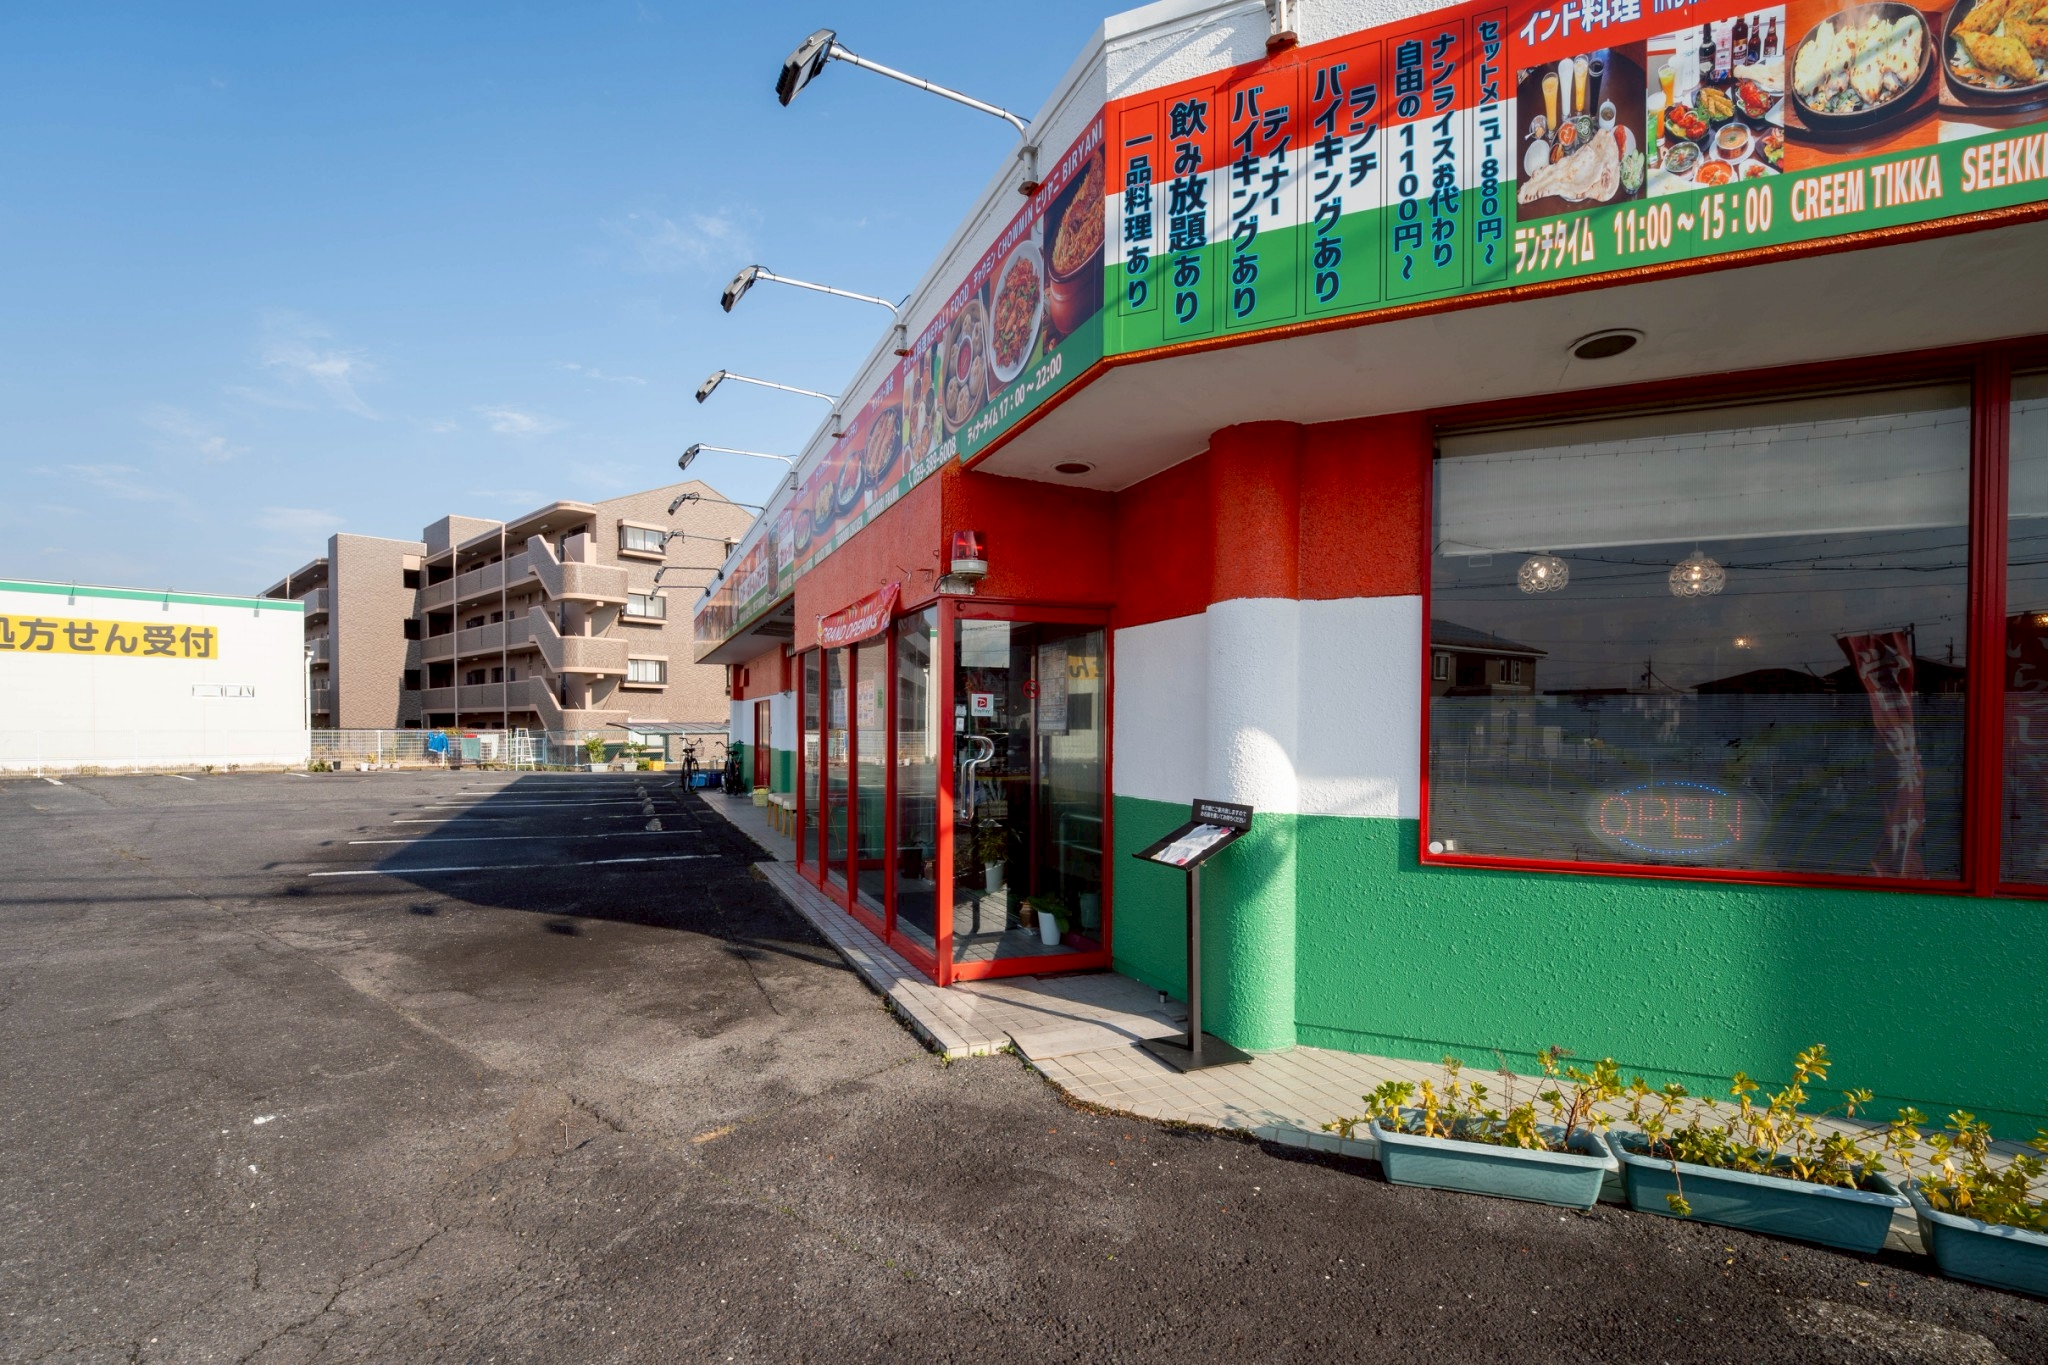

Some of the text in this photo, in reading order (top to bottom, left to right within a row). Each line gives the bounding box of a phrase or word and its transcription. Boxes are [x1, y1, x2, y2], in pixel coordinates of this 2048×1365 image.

[1520, 0, 1641, 46] インド料理
[1062, 119, 1104, 185] BIRYANI
[1262, 106, 1290, 216] ディナー
[1349, 85, 1378, 188] ランチ
[1428, 33, 1459, 268] ナンライスお代わり
[1168, 98, 1207, 324] 飲み放題あり
[1232, 86, 1265, 319] バイキングあり
[1313, 63, 1348, 304] バイキングあり
[1791, 168, 1866, 223] CREEM
[1870, 157, 1943, 209] TIKKA
[997, 203, 1034, 259] CHOWMIN
[1124, 133, 1153, 308] 一品料理あり
[1514, 216, 1595, 275] ランチタイム
[951, 282, 970, 317] FOOD
[823, 610, 879, 643] GRAND OPENING
[1600, 796, 1742, 841] OPEN
